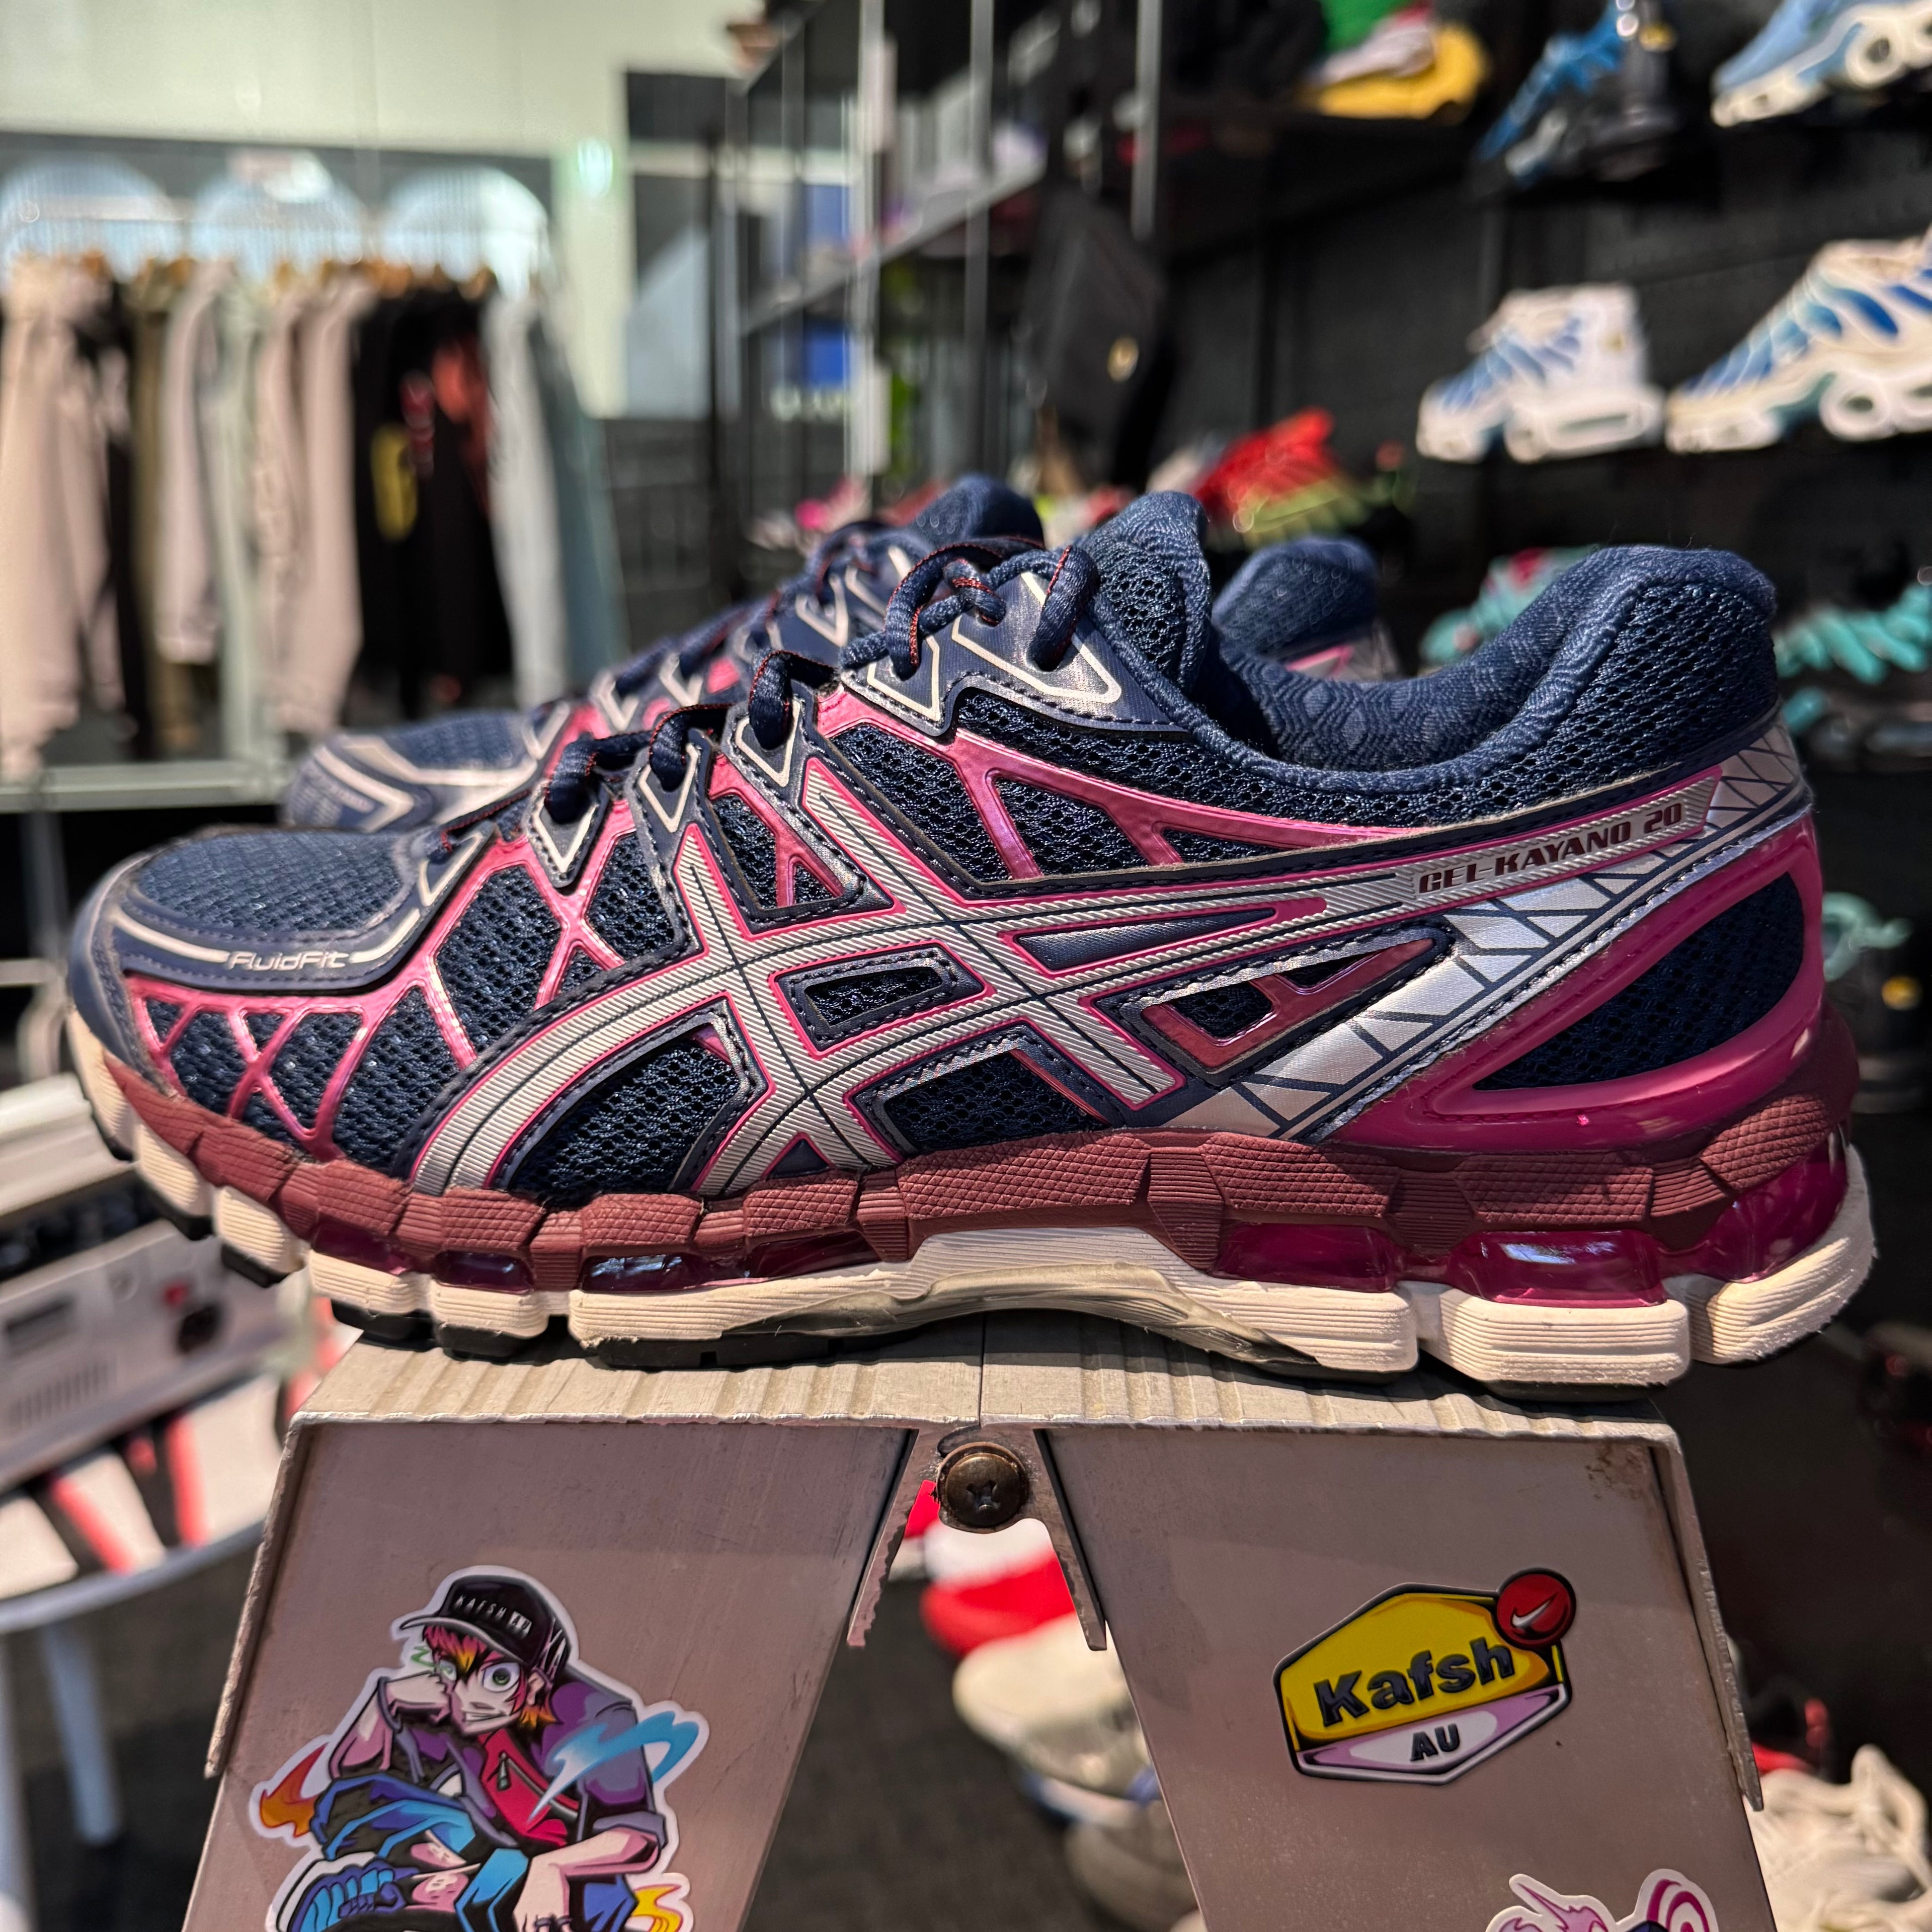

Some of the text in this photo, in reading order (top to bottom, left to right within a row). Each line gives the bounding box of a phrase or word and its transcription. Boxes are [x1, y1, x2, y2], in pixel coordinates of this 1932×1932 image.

[1419, 802, 1682, 894] GEL-KAYANO 20
[228, 950, 349, 971] FluidFit
[1314, 1636, 1515, 1727] Kafsh
[1410, 1723, 1460, 1761] AU
